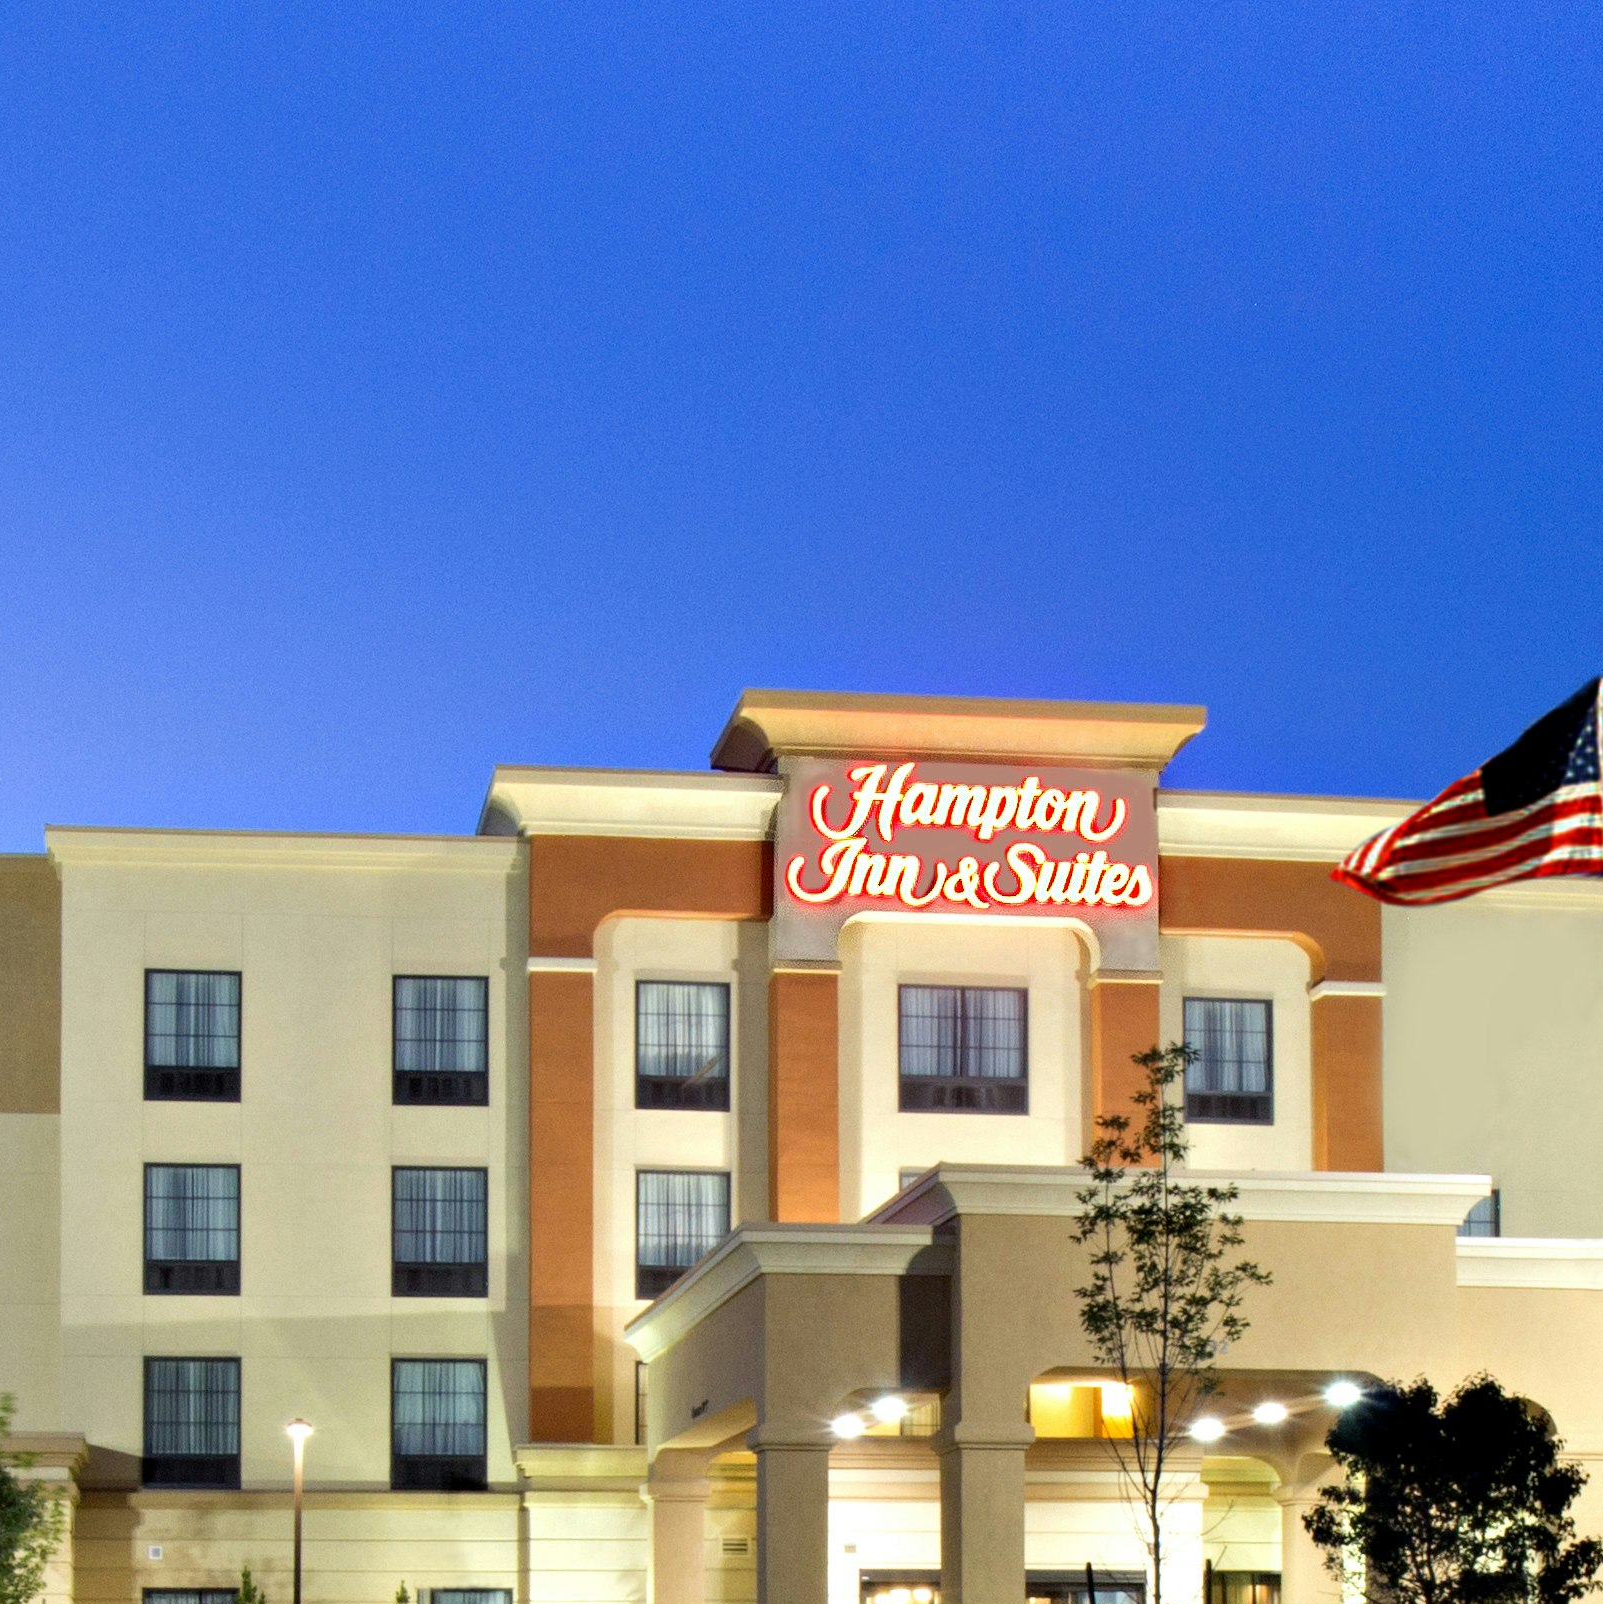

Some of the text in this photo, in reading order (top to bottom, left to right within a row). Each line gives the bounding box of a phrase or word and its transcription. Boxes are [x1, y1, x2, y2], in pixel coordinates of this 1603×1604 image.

[812, 763, 1126, 842] Hampton
[789, 838, 1153, 908] Inn & Suites
